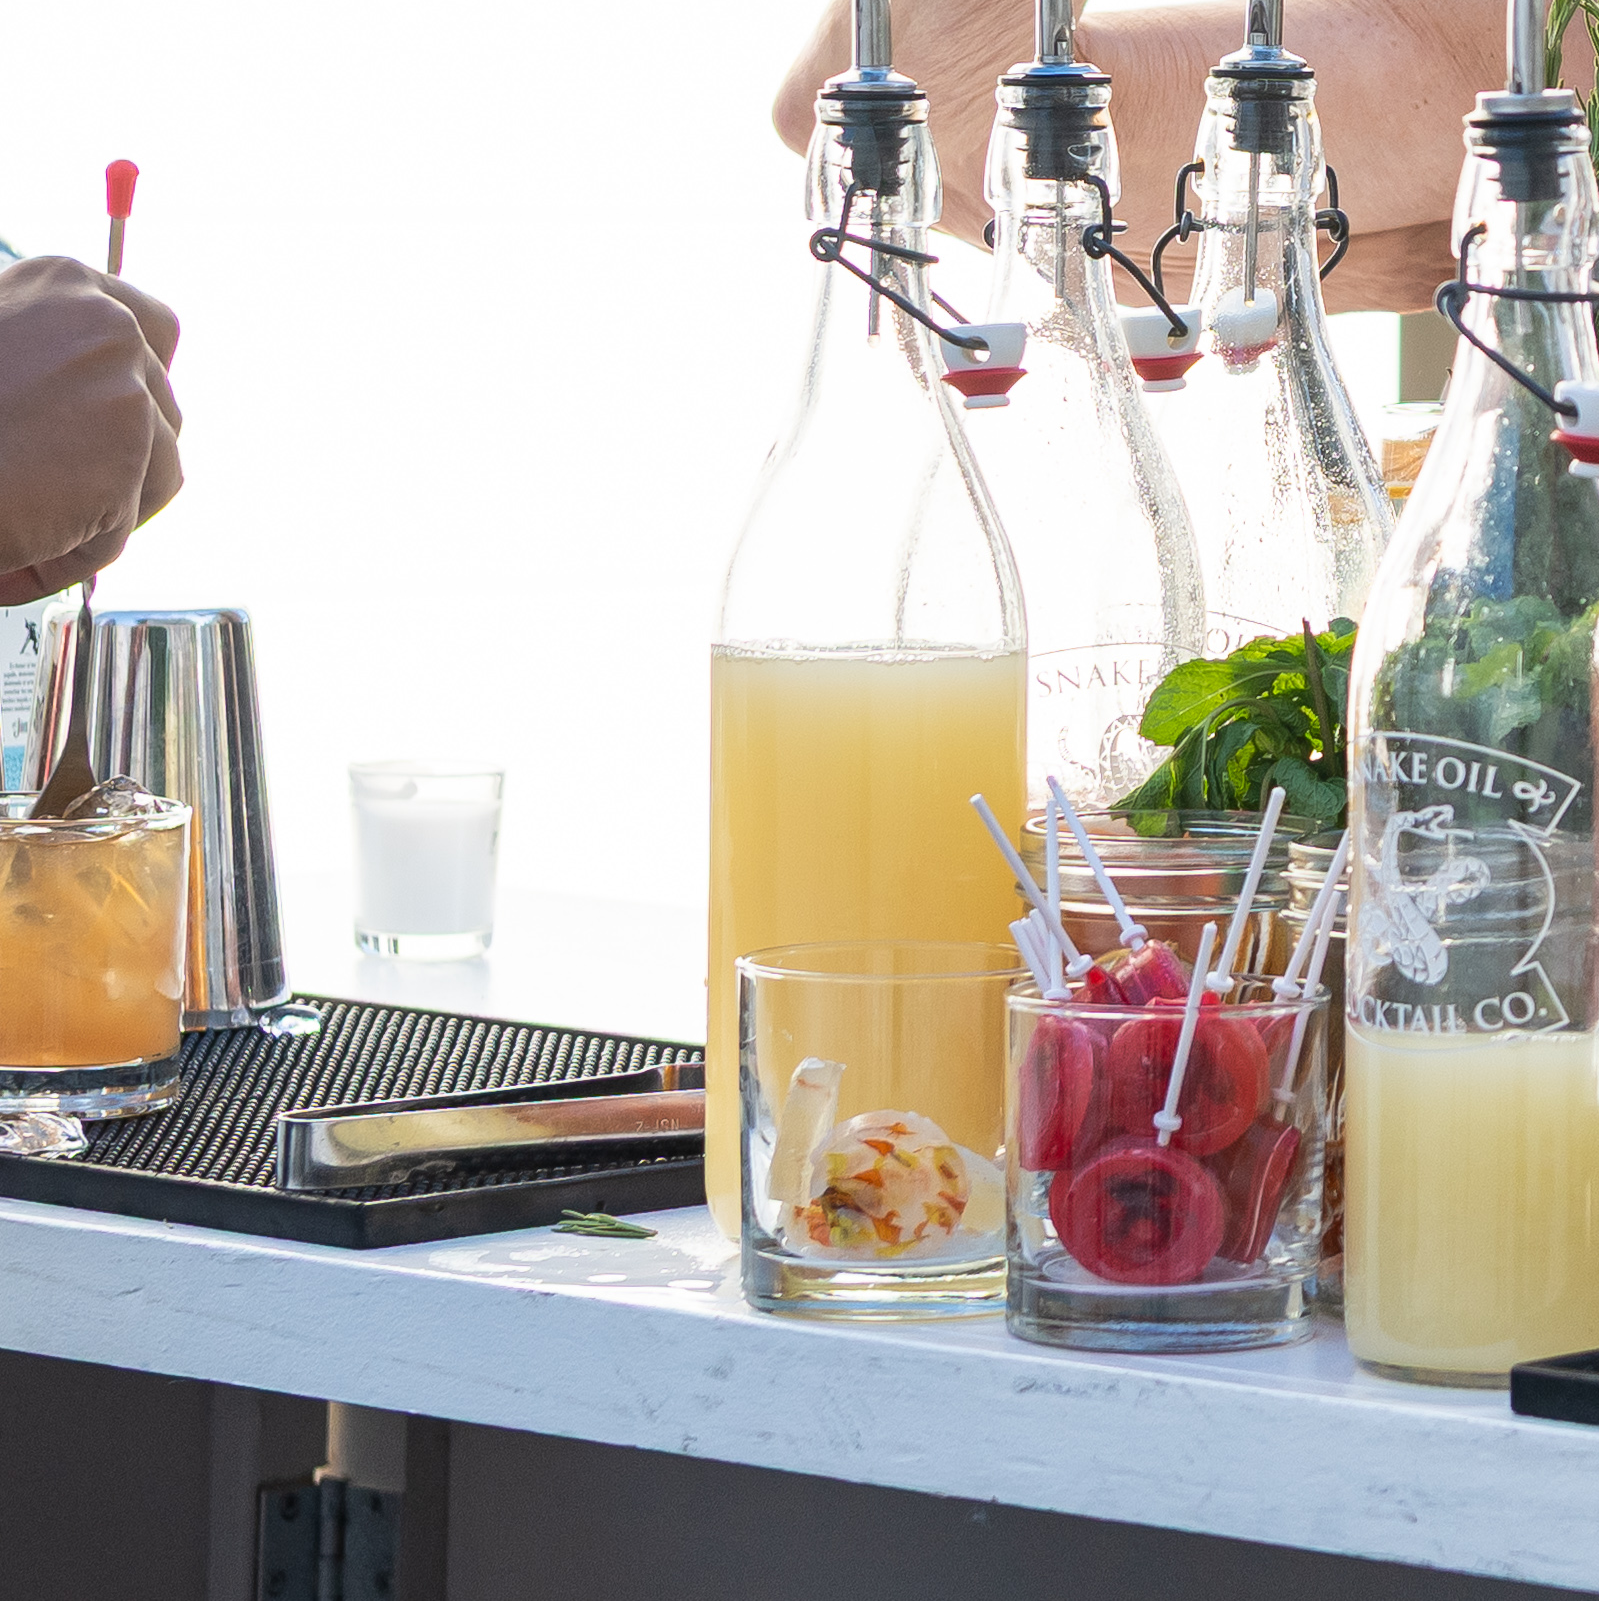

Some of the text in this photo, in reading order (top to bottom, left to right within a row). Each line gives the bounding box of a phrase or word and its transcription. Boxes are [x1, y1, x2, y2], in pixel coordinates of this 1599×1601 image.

[1037, 660, 1150, 697] SNAKE
[1357, 752, 1557, 813] NAKE OIL &
[1475, 992, 1547, 1031] CO.
